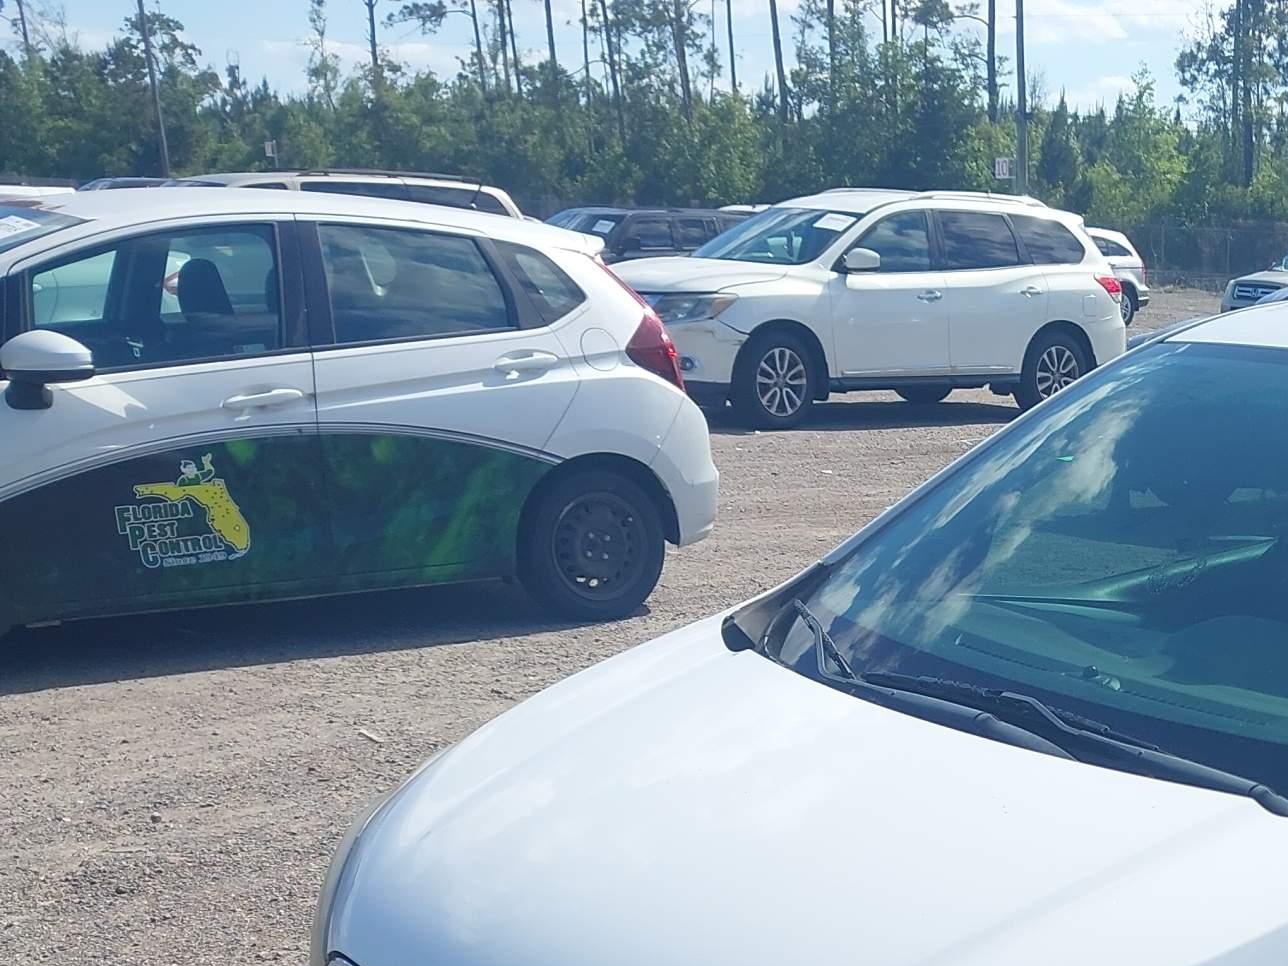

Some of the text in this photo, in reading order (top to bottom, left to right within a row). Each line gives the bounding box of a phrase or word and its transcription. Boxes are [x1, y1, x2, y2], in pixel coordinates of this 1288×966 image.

[996, 159, 1008, 177] 10
[115, 501, 193, 534] FLORIDA
[127, 521, 178, 550] PEST
[140, 534, 224, 568] CONTROL
